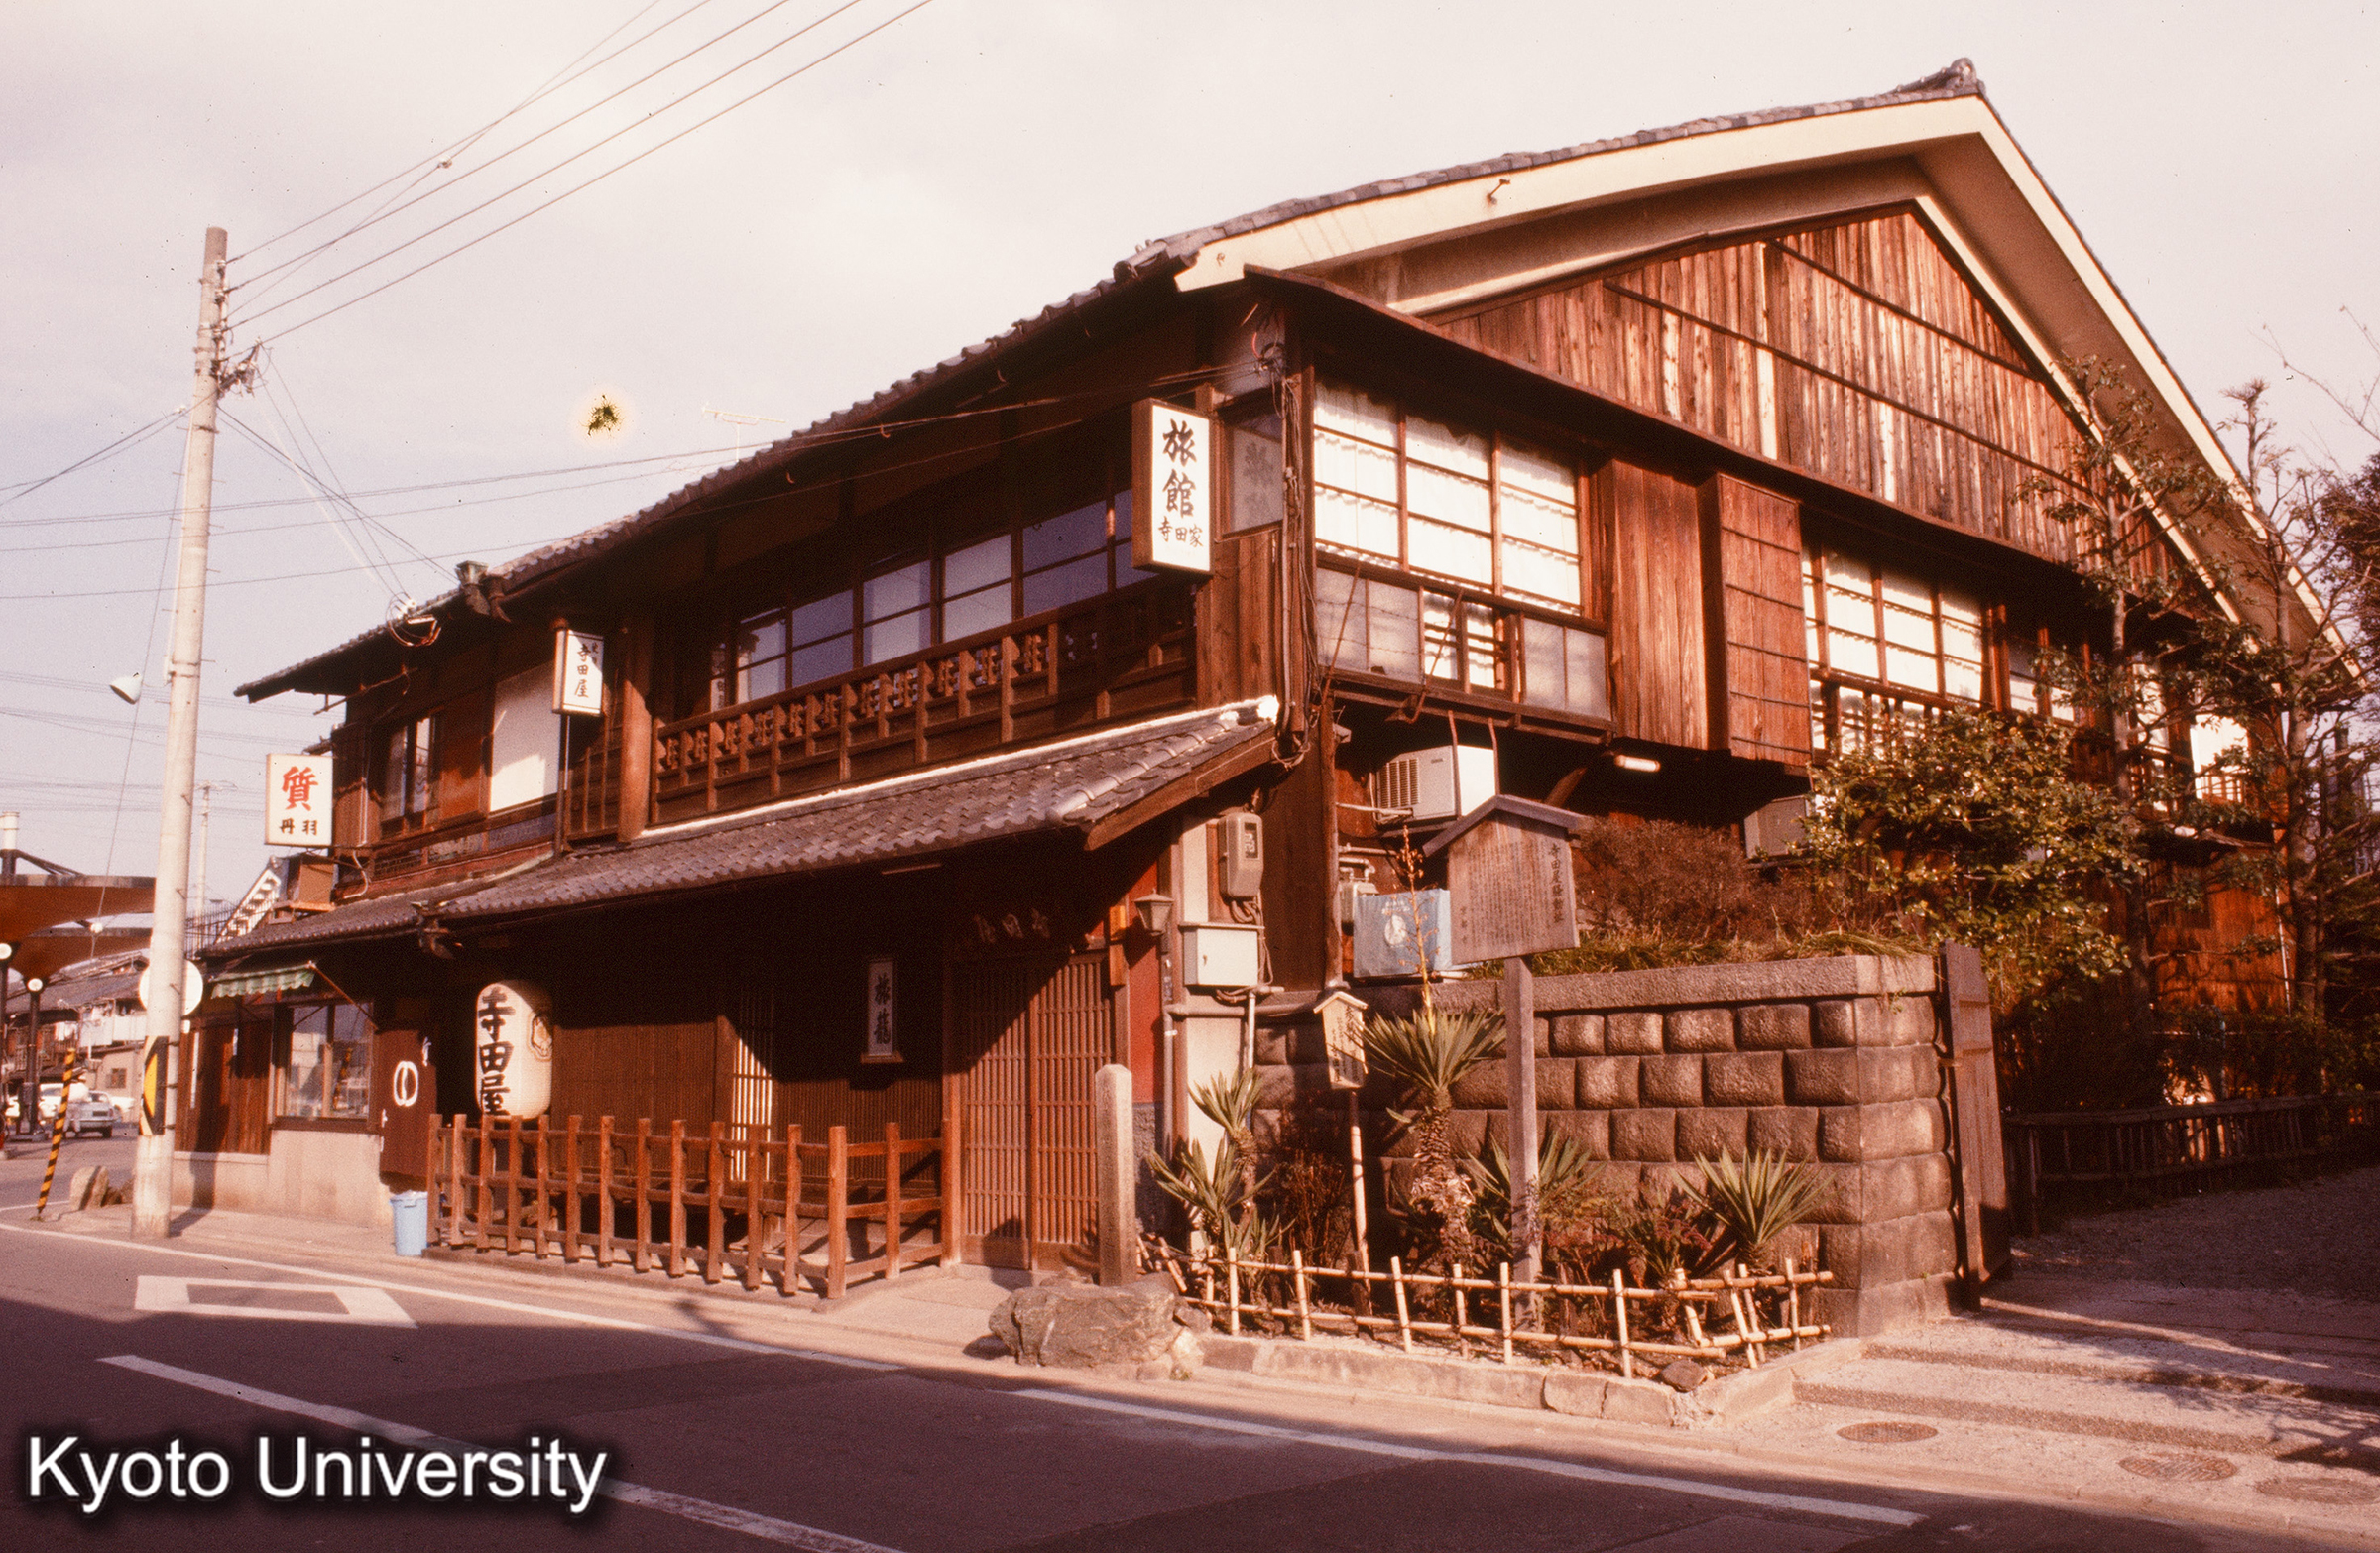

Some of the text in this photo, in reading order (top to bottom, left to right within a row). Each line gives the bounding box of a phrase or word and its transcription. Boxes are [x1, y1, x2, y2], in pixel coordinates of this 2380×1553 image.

[1162, 418, 1197, 519] 旅館
[1157, 515, 1204, 548] 寺田家
[574, 643, 592, 698] 寺田屋
[281, 765, 319, 812] 質
[279, 817, 318, 836] 丹羽
[478, 986, 516, 1116] 寺田屋
